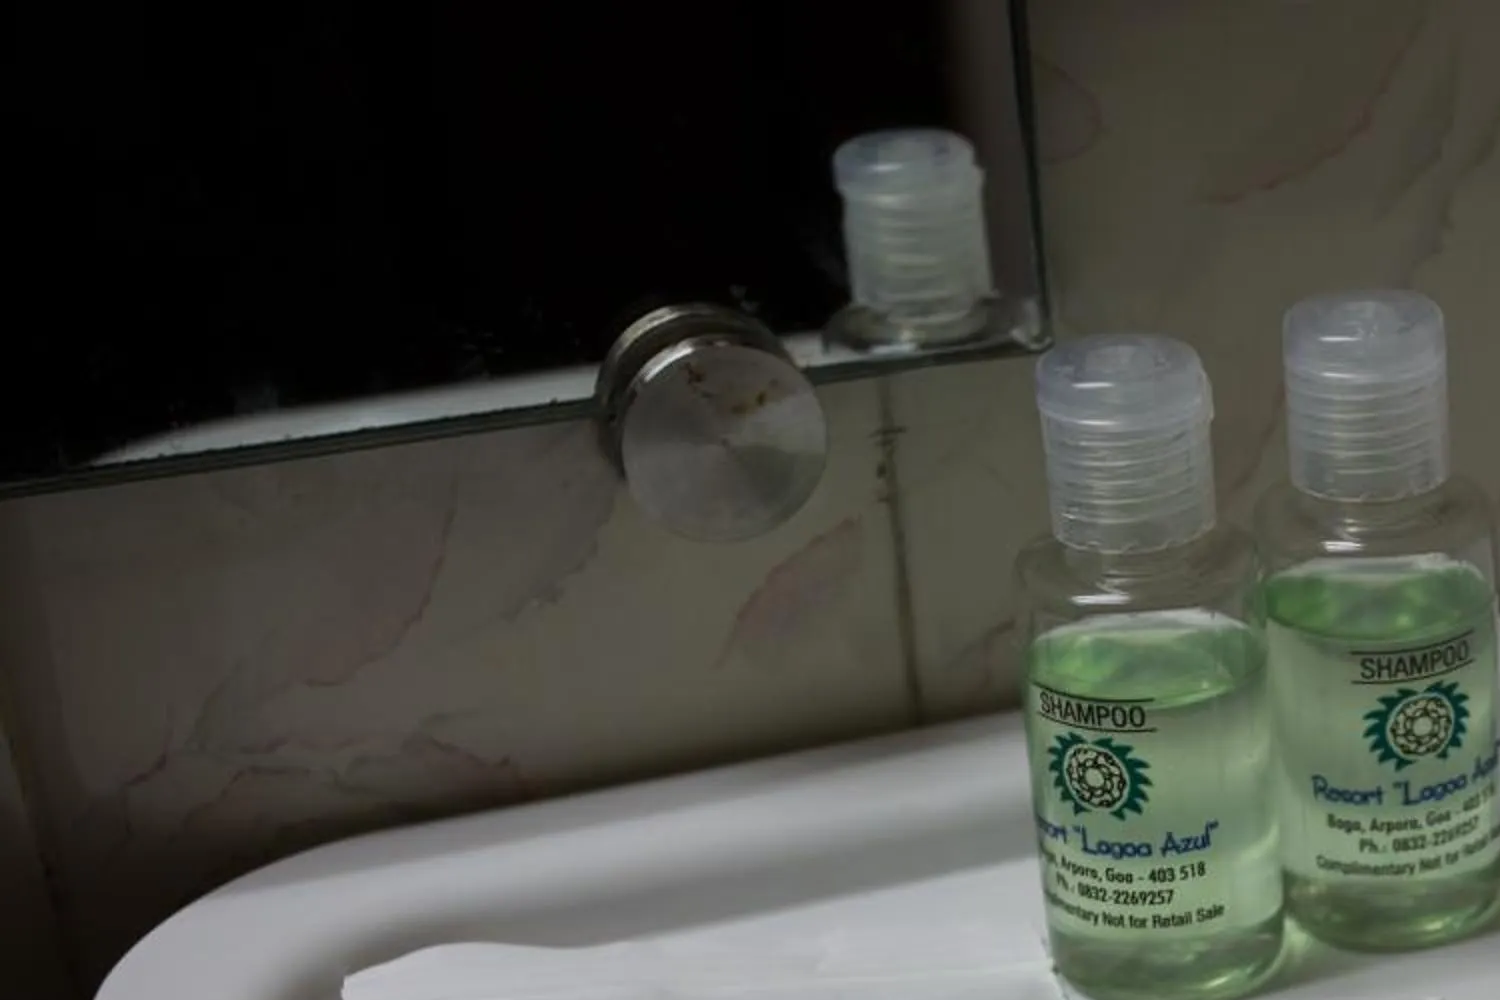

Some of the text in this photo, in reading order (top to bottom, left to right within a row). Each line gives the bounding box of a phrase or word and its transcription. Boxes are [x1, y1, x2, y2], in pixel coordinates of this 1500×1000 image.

[1360, 640, 1470, 680] SHAMPOO
[1039, 692, 1146, 728] SHAMPOO
[1311, 774, 1382, 805] Resort
[1105, 867, 1134, 885] Goa
[1149, 867, 1176, 884] 403
[1180, 860, 1207, 881] 518
[1078, 882, 1175, 906] 0832-2269257
[1102, 912, 1126, 928] Not
[1129, 914, 1149, 929] for
[1152, 911, 1193, 929] Retail
[1196, 903, 1226, 923] Sale
